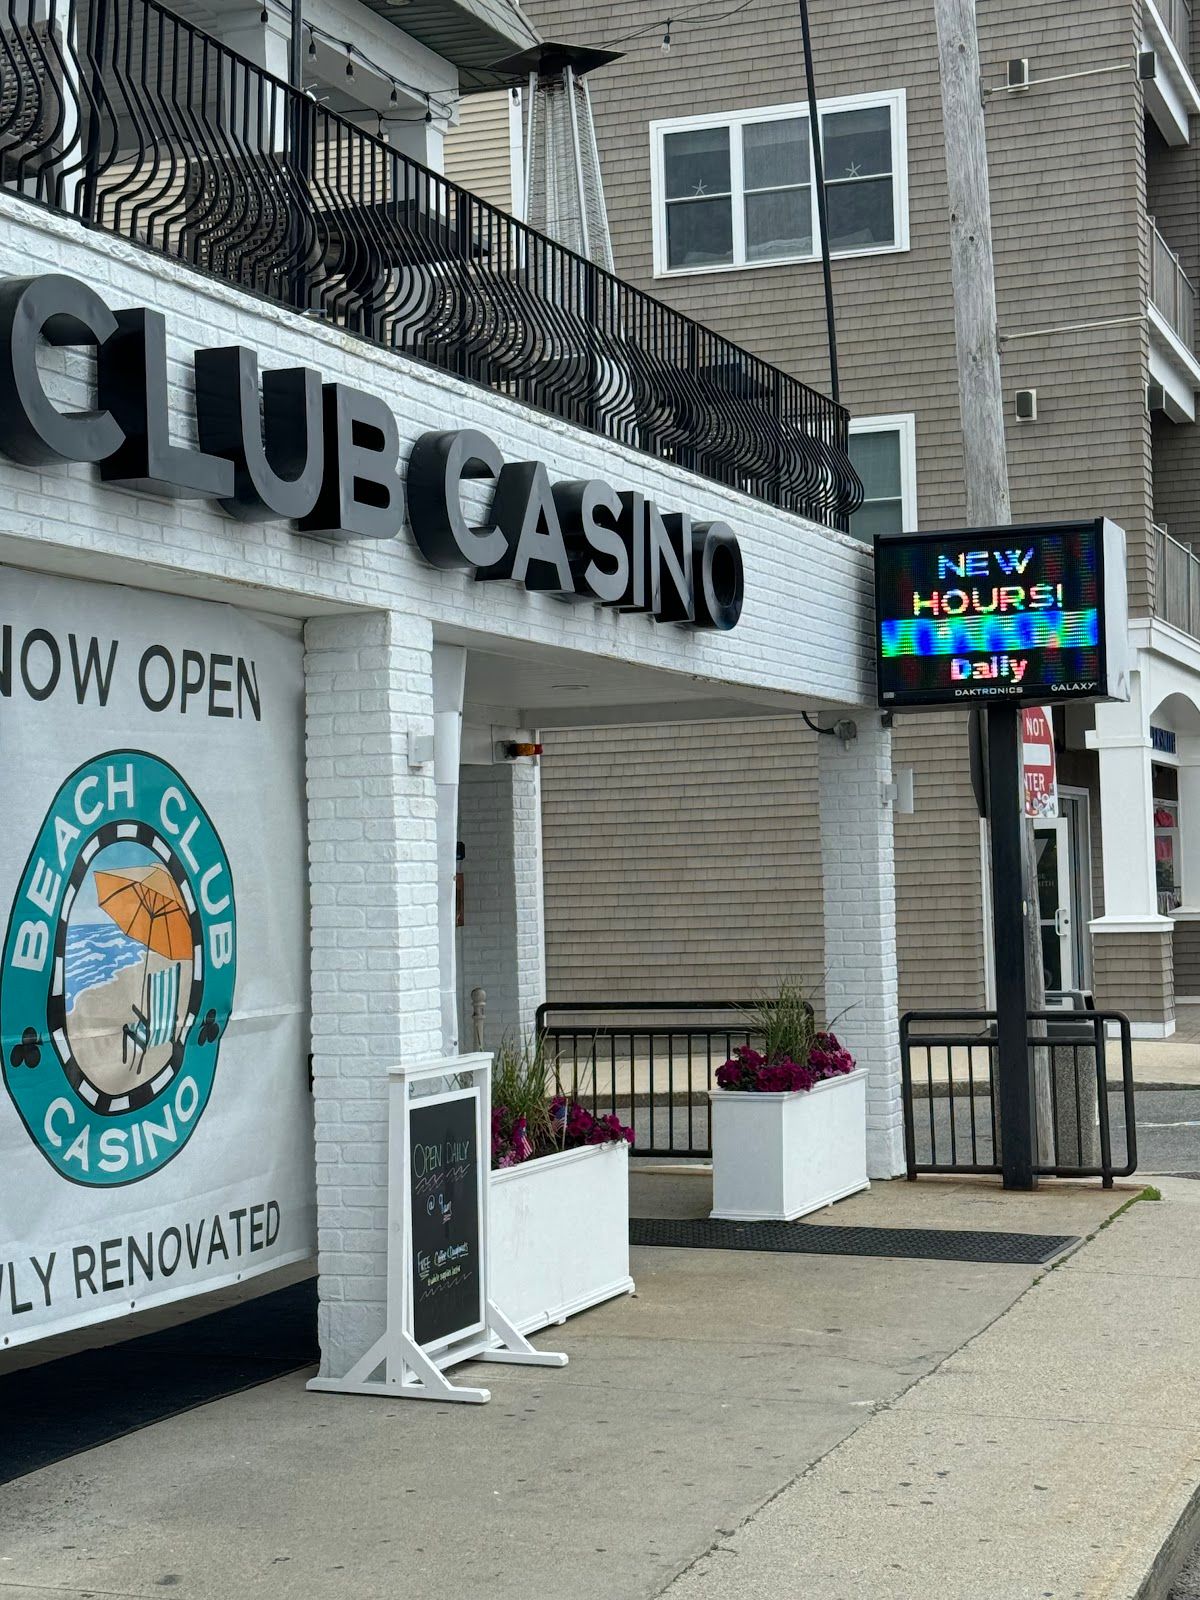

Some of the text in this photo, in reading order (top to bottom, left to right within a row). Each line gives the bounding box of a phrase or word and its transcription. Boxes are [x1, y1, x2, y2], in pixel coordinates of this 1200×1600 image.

[0, 274, 744, 632] CLUB CASINO
[938, 548, 1034, 579] NEW
[913, 583, 1063, 616] HOURS!
[138, 644, 262, 722] OPEN
[950, 655, 1028, 683] Daily
[954, 686, 1024, 697] DAKTRONICS
[1051, 681, 1095, 692] GALAXY
[1026, 717, 1045, 736] NOT
[1024, 772, 1045, 791] NTER
[13, 763, 233, 973] BEACH CLUB
[43, 1074, 200, 1173] CASINO
[413, 1140, 470, 1178] OPEN DAILY
[0, 1199, 281, 1314] LY RENOVATED
